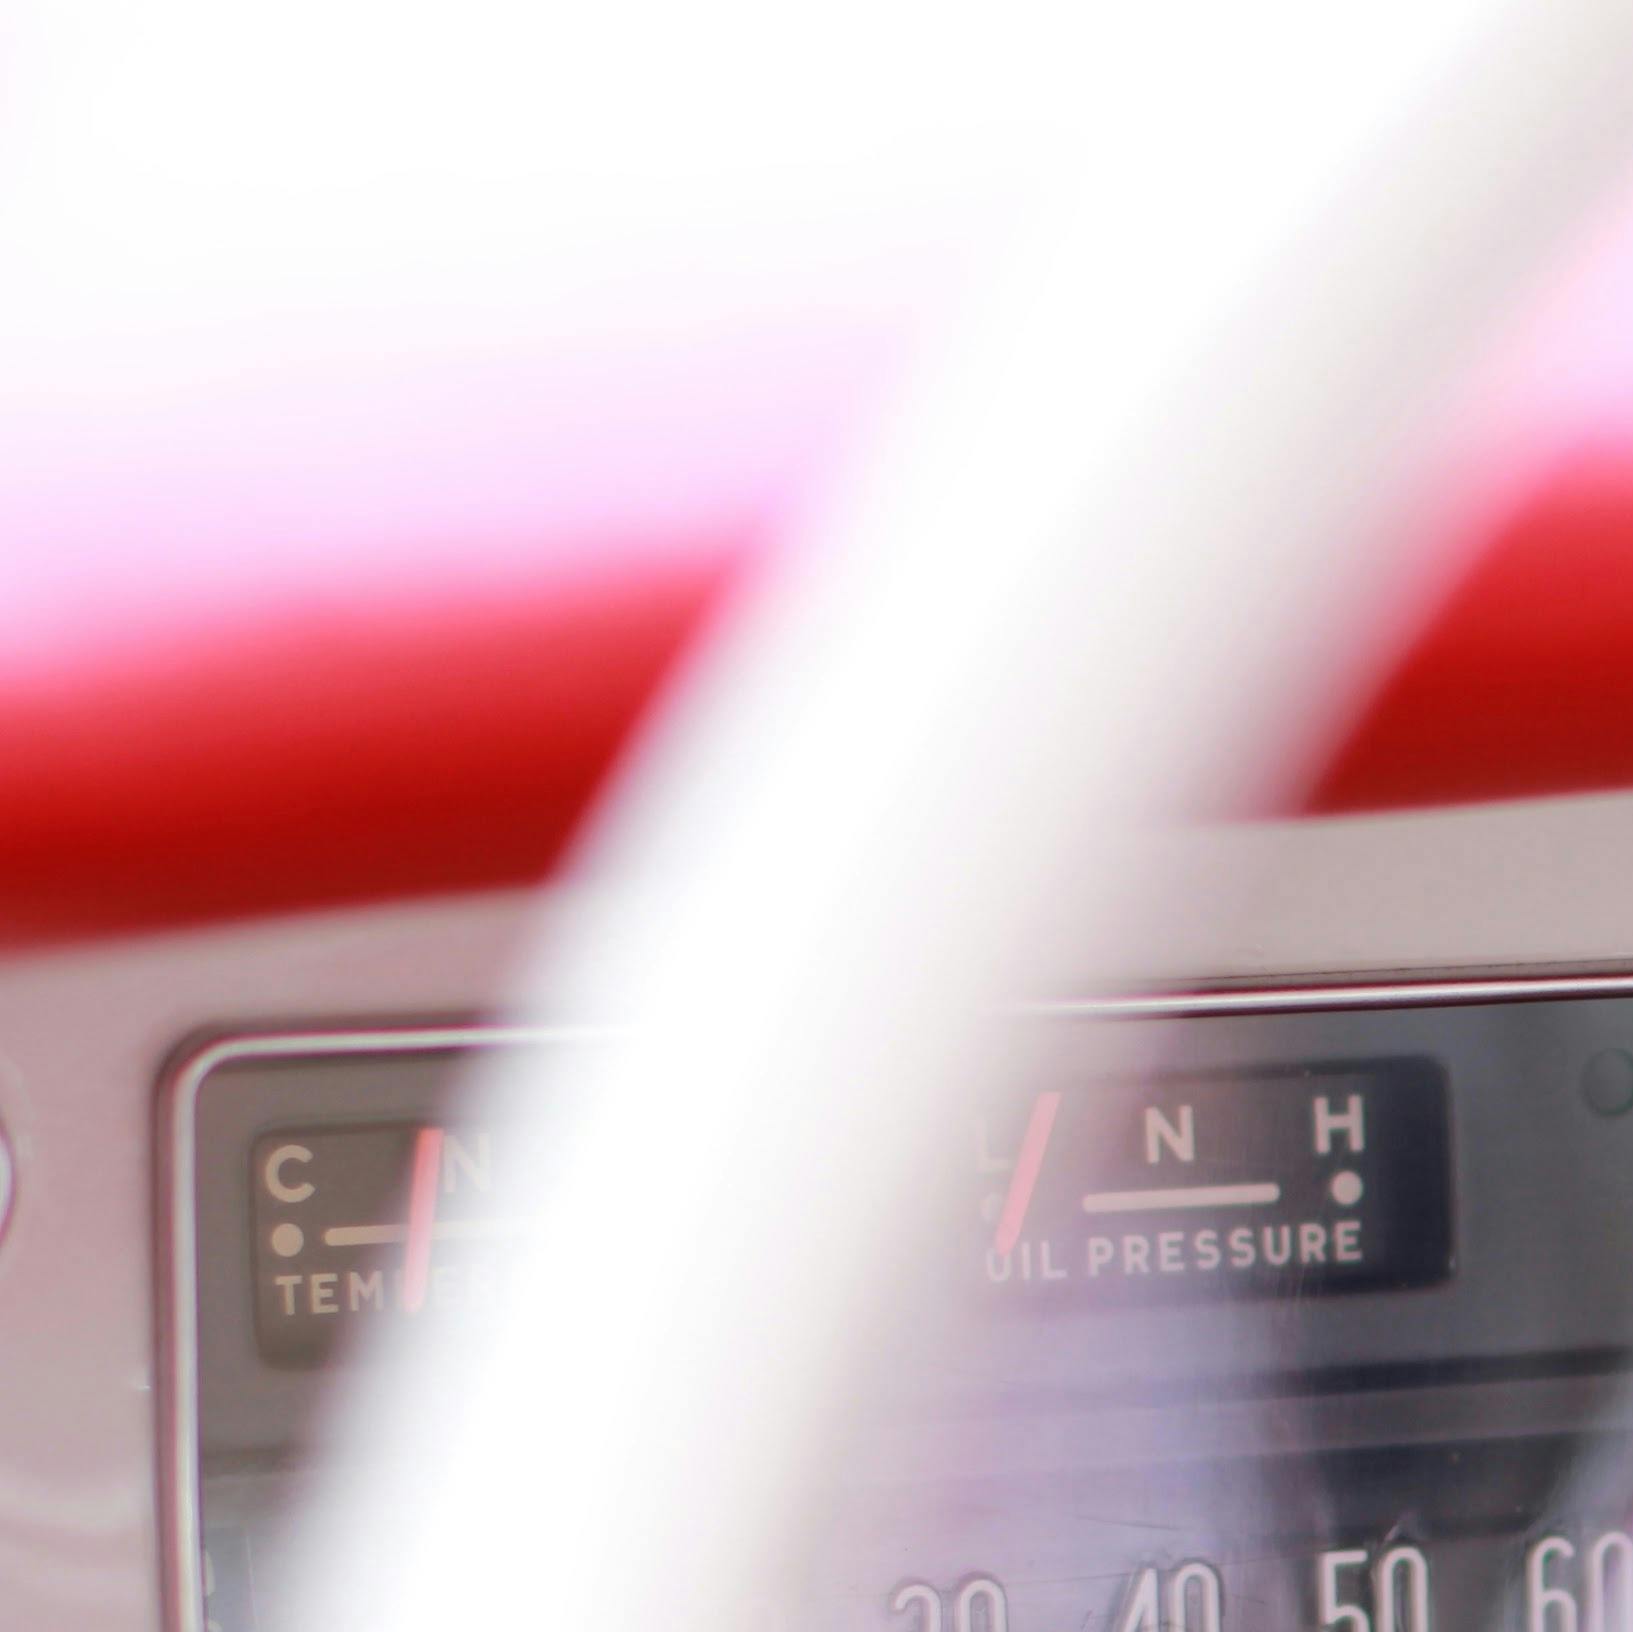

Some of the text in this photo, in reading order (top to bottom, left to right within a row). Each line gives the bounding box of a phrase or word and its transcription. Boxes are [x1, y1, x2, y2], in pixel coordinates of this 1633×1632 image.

[1144, 1104, 1196, 1164] N
[1312, 1093, 1366, 1155] H
[264, 1143, 317, 1204] C
[1087, 1219, 1363, 1278] PRESSURE
